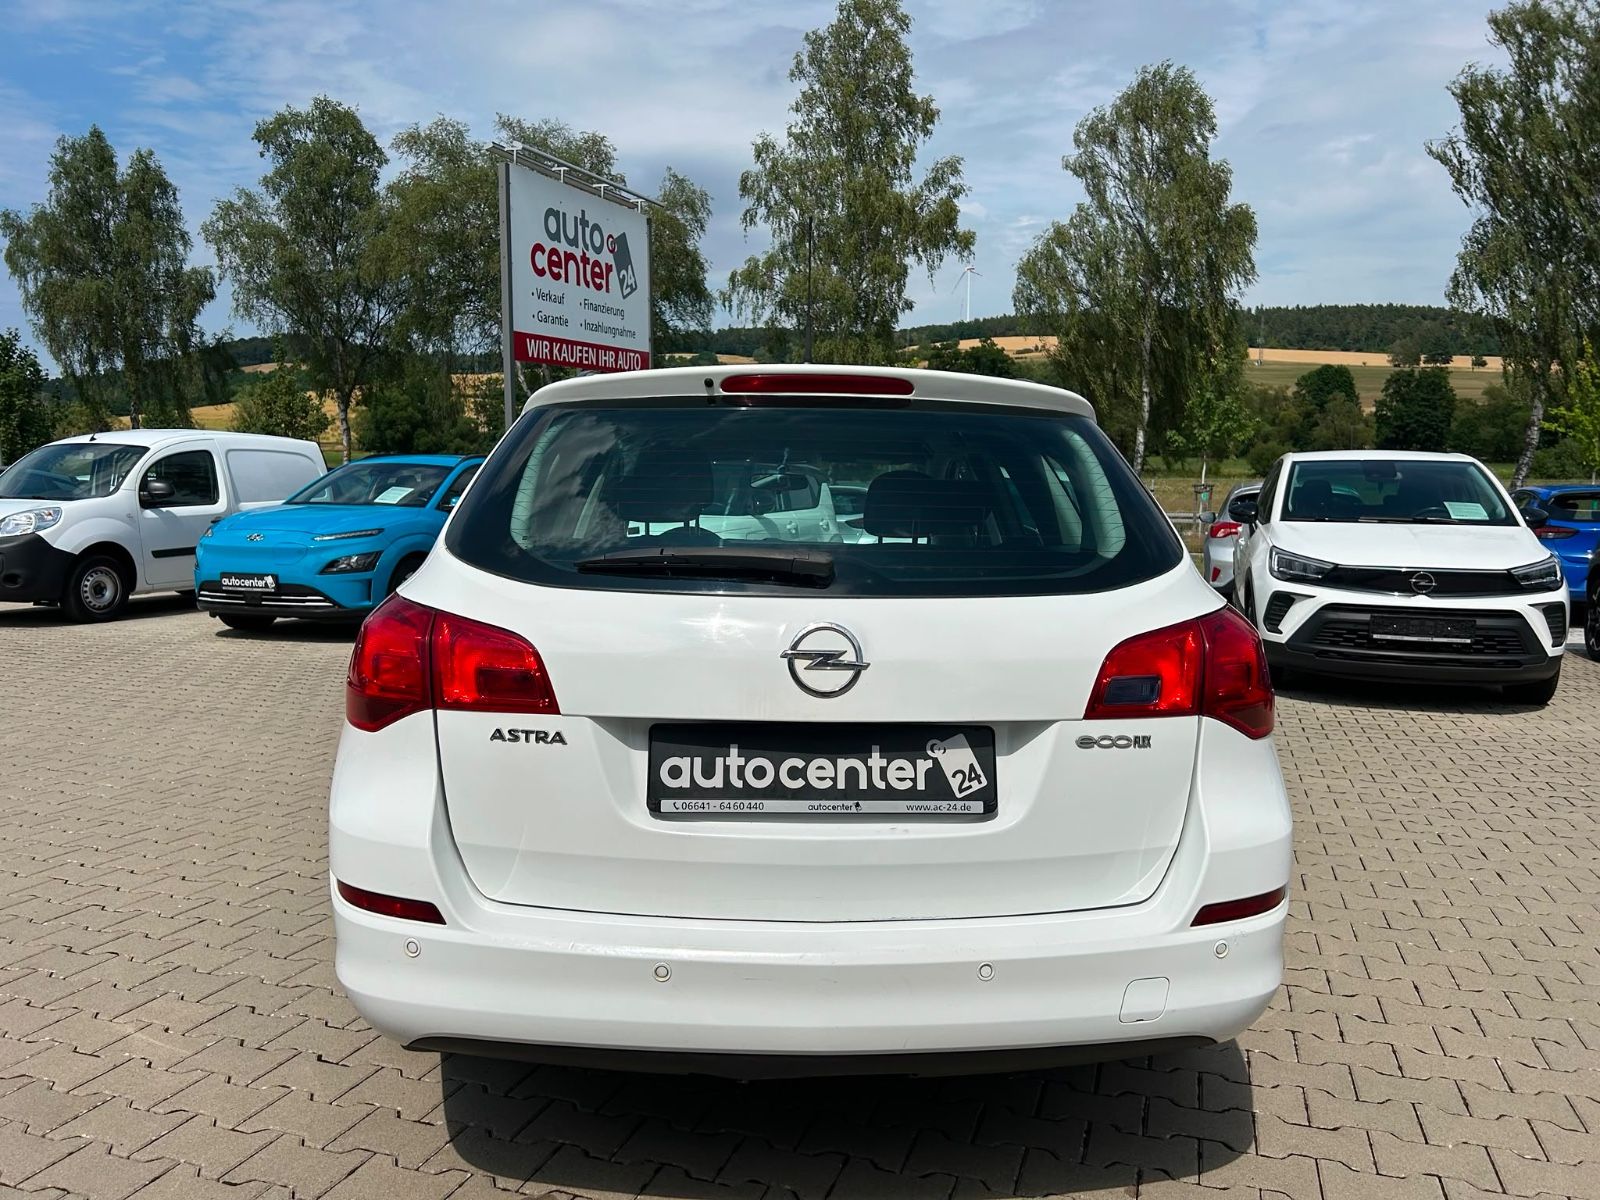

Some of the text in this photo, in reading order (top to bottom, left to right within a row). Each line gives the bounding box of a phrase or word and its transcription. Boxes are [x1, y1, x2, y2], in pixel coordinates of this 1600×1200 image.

[544, 207, 604, 255] auto
[531, 243, 613, 293] center
[620, 264, 637, 296] 24
[536, 288, 565, 305] Verkauf
[537, 310, 569, 327] Garantie
[583, 299, 625, 320] Finanzierung
[584, 319, 636, 339] Inzahlungnahme
[526, 338, 641, 370] WIR KAUFEN IHR AUTO
[222, 576, 265, 587] autocenter
[489, 728, 568, 746] ASTRA
[659, 743, 933, 791] autocenter
[951, 762, 983, 795] 24
[681, 801, 710, 811] 06641
[807, 802, 853, 812] autocenter
[906, 802, 972, 812] www.ac-24.de
